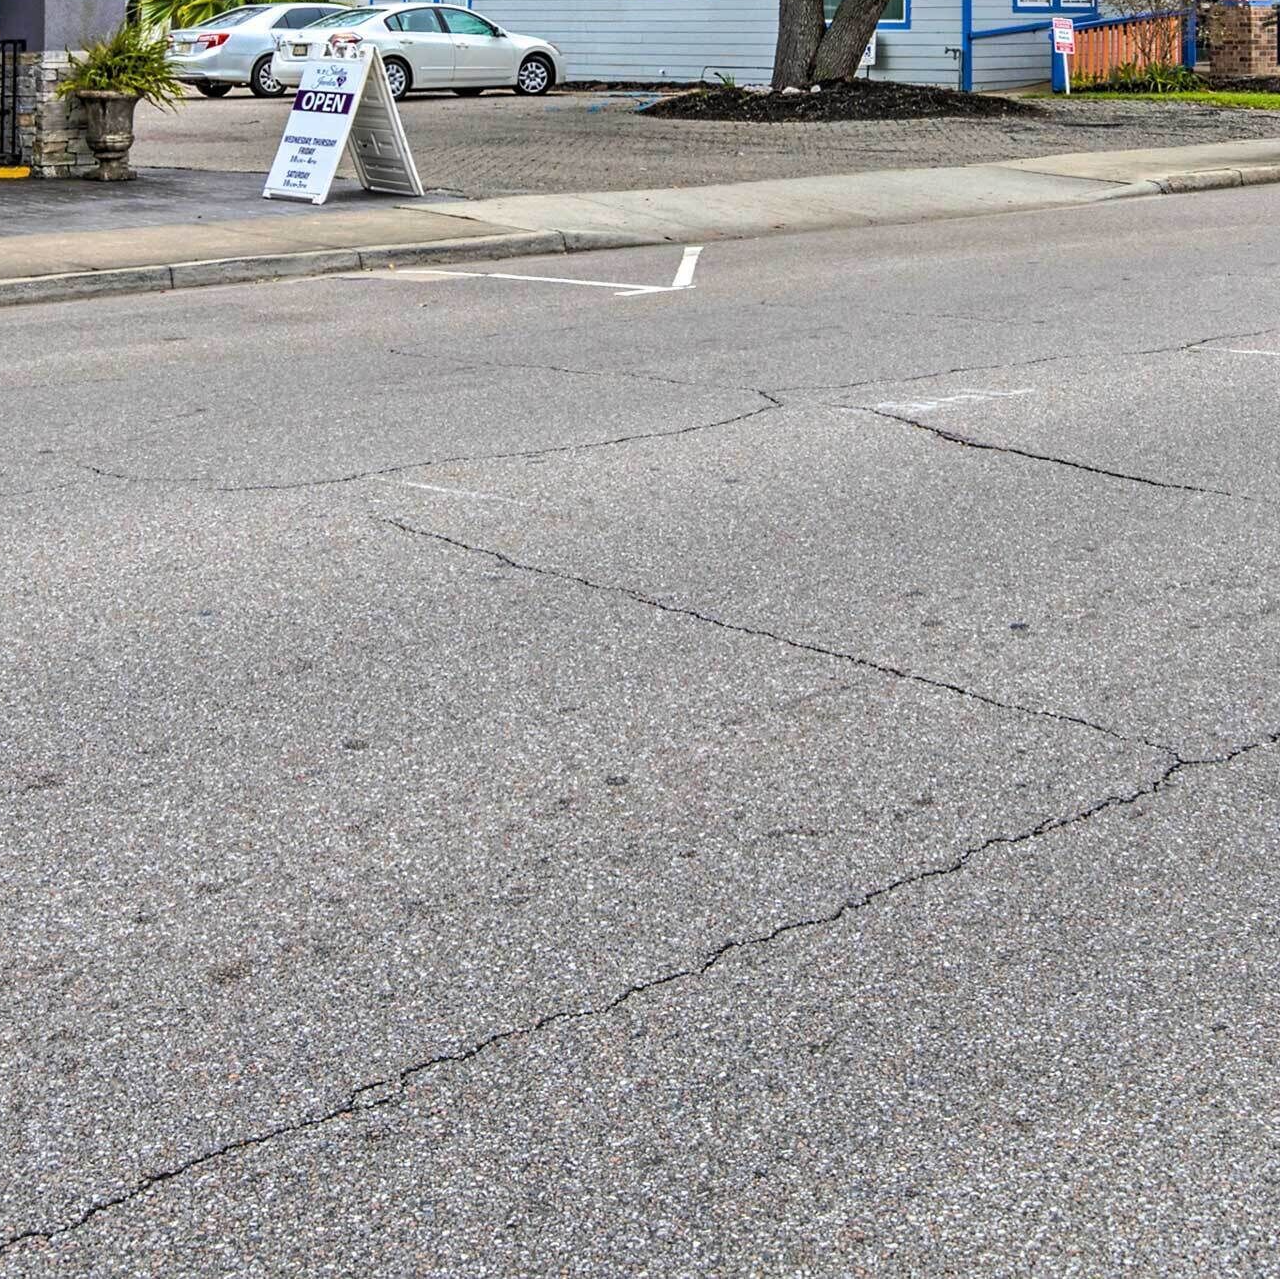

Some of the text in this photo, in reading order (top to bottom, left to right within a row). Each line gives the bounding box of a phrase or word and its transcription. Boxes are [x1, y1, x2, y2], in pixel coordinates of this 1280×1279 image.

[302, 92, 347, 113] OPEN
[298, 147, 316, 155] FRIDAY
[286, 170, 311, 180] SATURDAY
